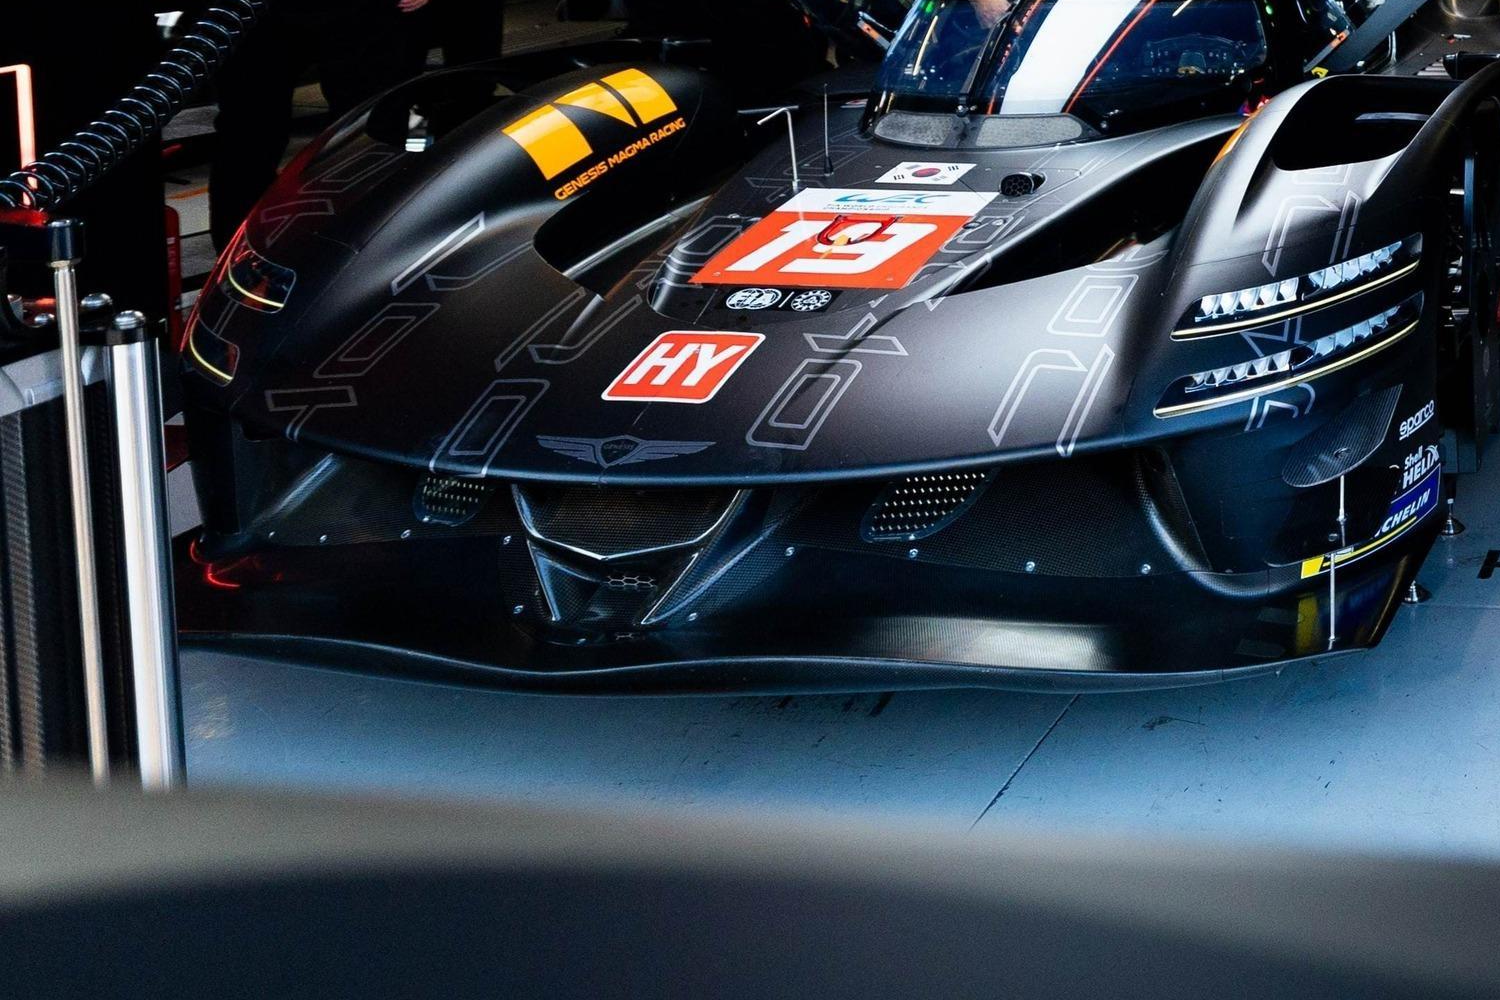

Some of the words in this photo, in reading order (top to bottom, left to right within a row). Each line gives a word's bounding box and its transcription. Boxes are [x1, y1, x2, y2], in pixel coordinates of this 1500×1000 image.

[554, 161, 609, 200] GENESIS
[608, 137, 651, 168] MAGMA
[649, 117, 687, 144] RACING
[724, 219, 938, 275] 19
[622, 343, 749, 386] HY
[1399, 400, 1434, 439] sparco
[1404, 446, 1423, 470] Shell
